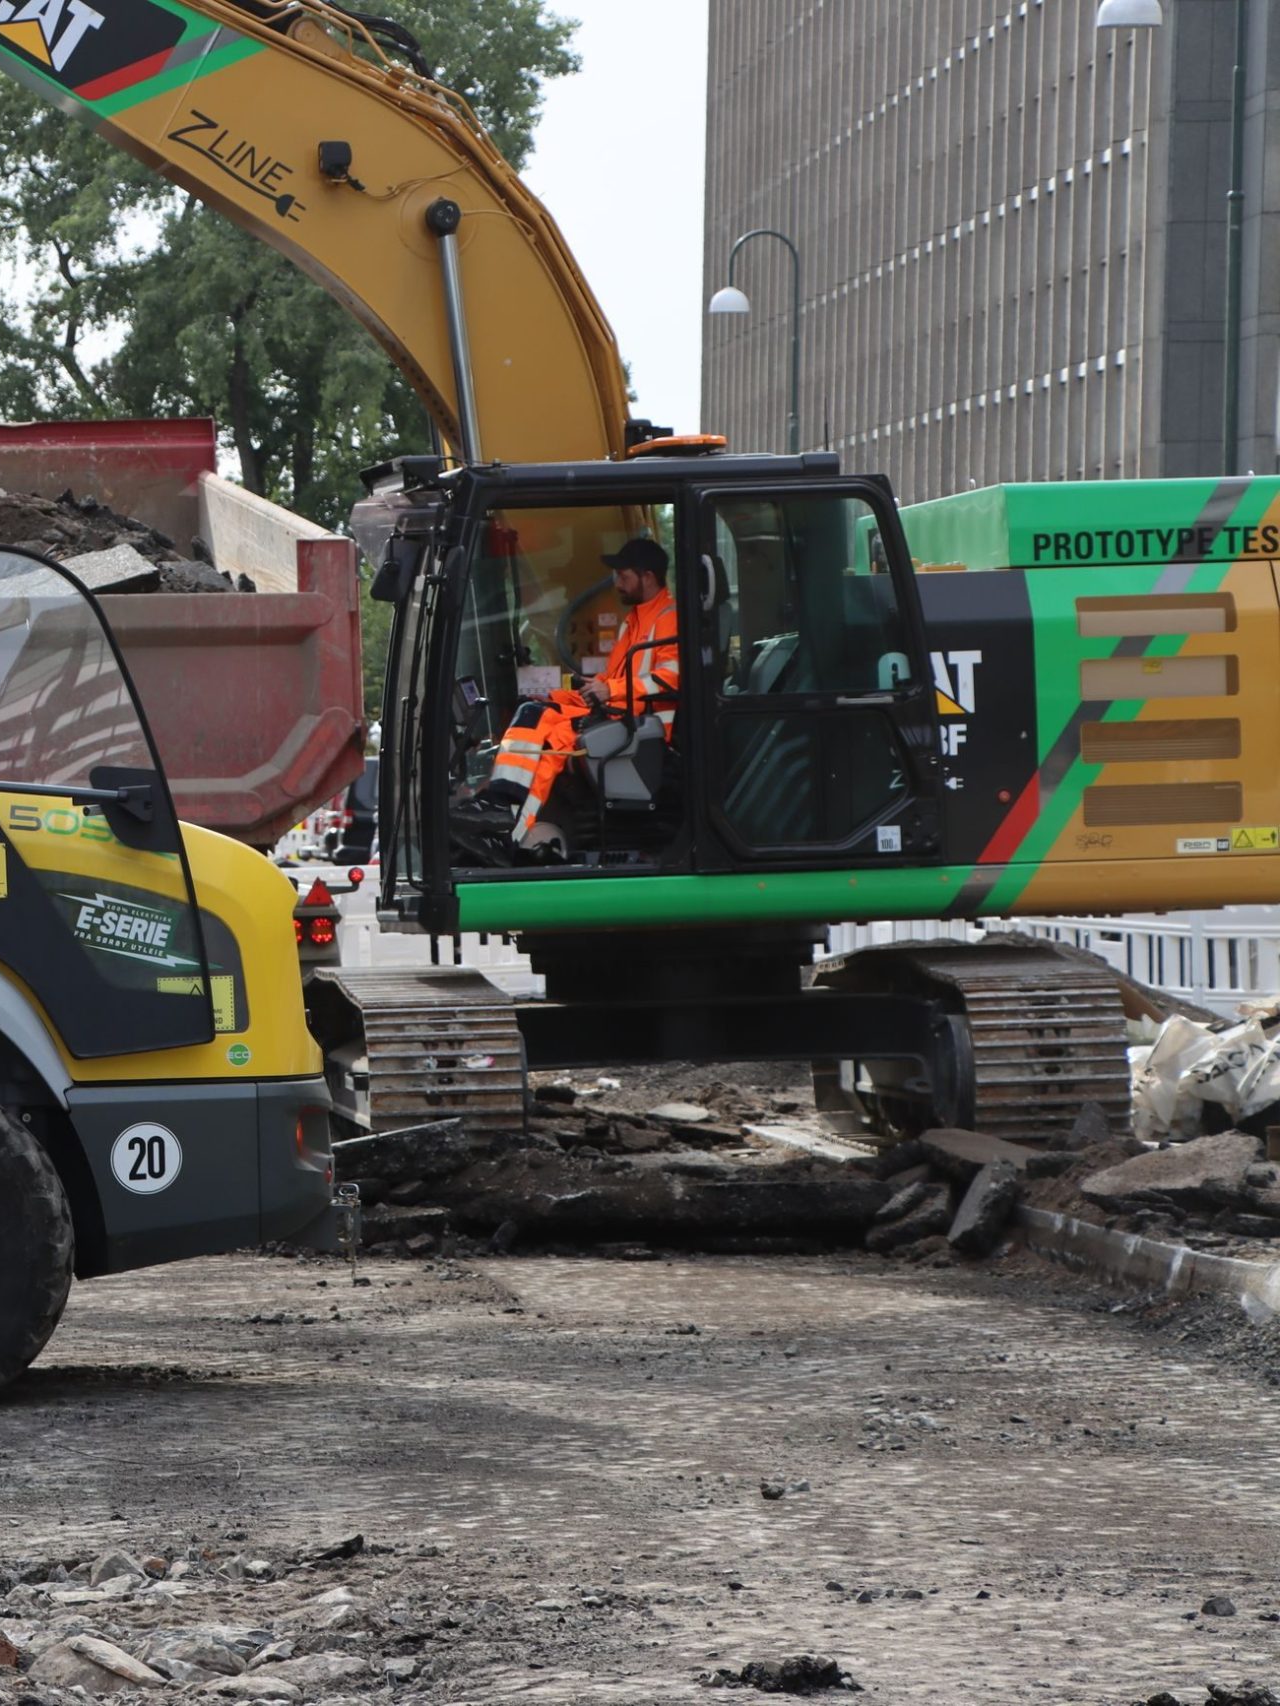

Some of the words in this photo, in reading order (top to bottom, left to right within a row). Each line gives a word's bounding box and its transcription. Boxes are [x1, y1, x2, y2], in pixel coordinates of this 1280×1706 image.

[1033, 526, 1213, 561] PROTOTYPE
[1223, 525, 1280, 554] TES
[76, 905, 171, 948] E-SERIE
[131, 909, 173, 923] ELEKTRISK
[73, 930, 92, 940] FRA
[130, 944, 164, 957] UTLEIE
[128, 1135, 166, 1181] 20
